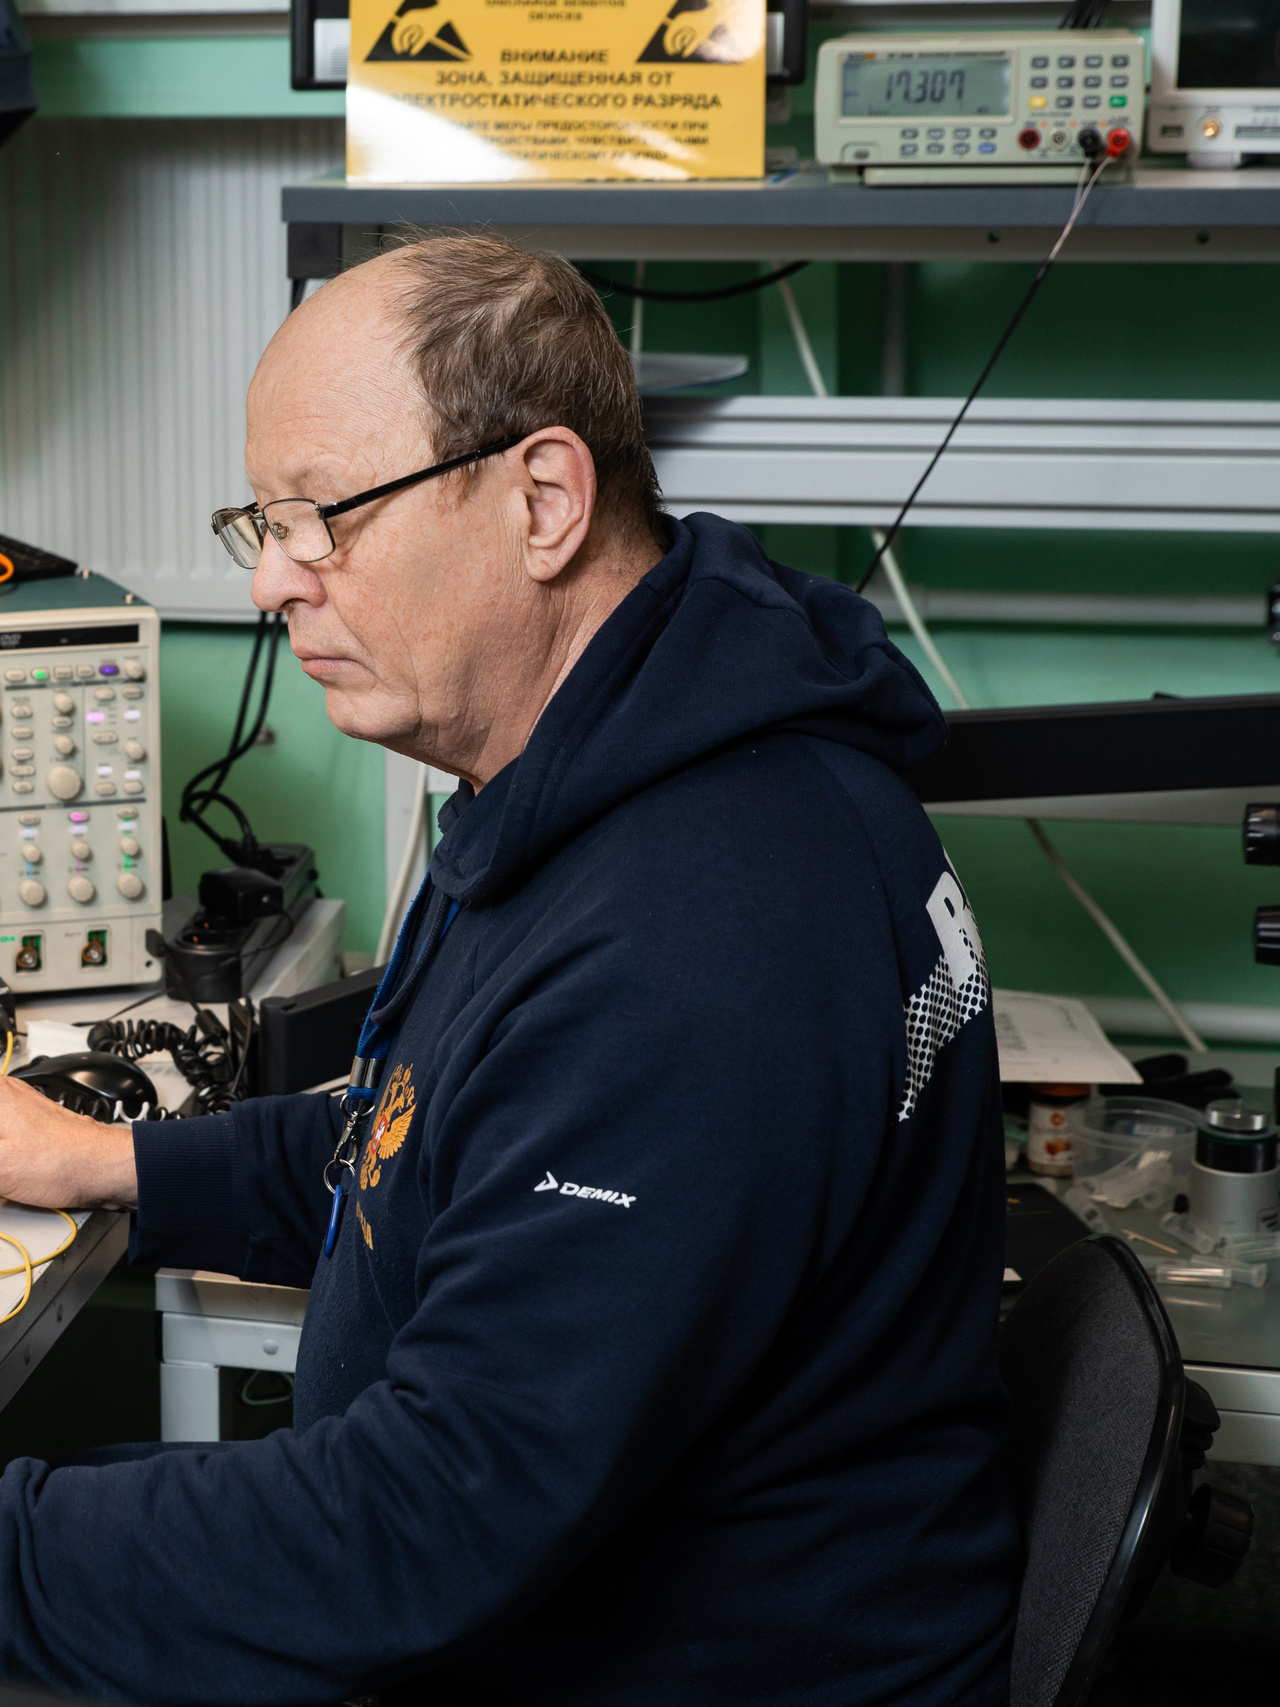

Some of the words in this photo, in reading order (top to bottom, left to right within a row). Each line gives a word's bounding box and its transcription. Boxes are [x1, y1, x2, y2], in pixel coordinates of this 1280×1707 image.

[500, 49, 609, 64] ВНИМАНИЕ
[499, 71, 643, 88] ЗАЩИЩЕННАЯ
[648, 71, 674, 86] ОТ
[632, 93, 723, 110] РАЗРЯДА
[558, 1181, 637, 1209] DEMIX
